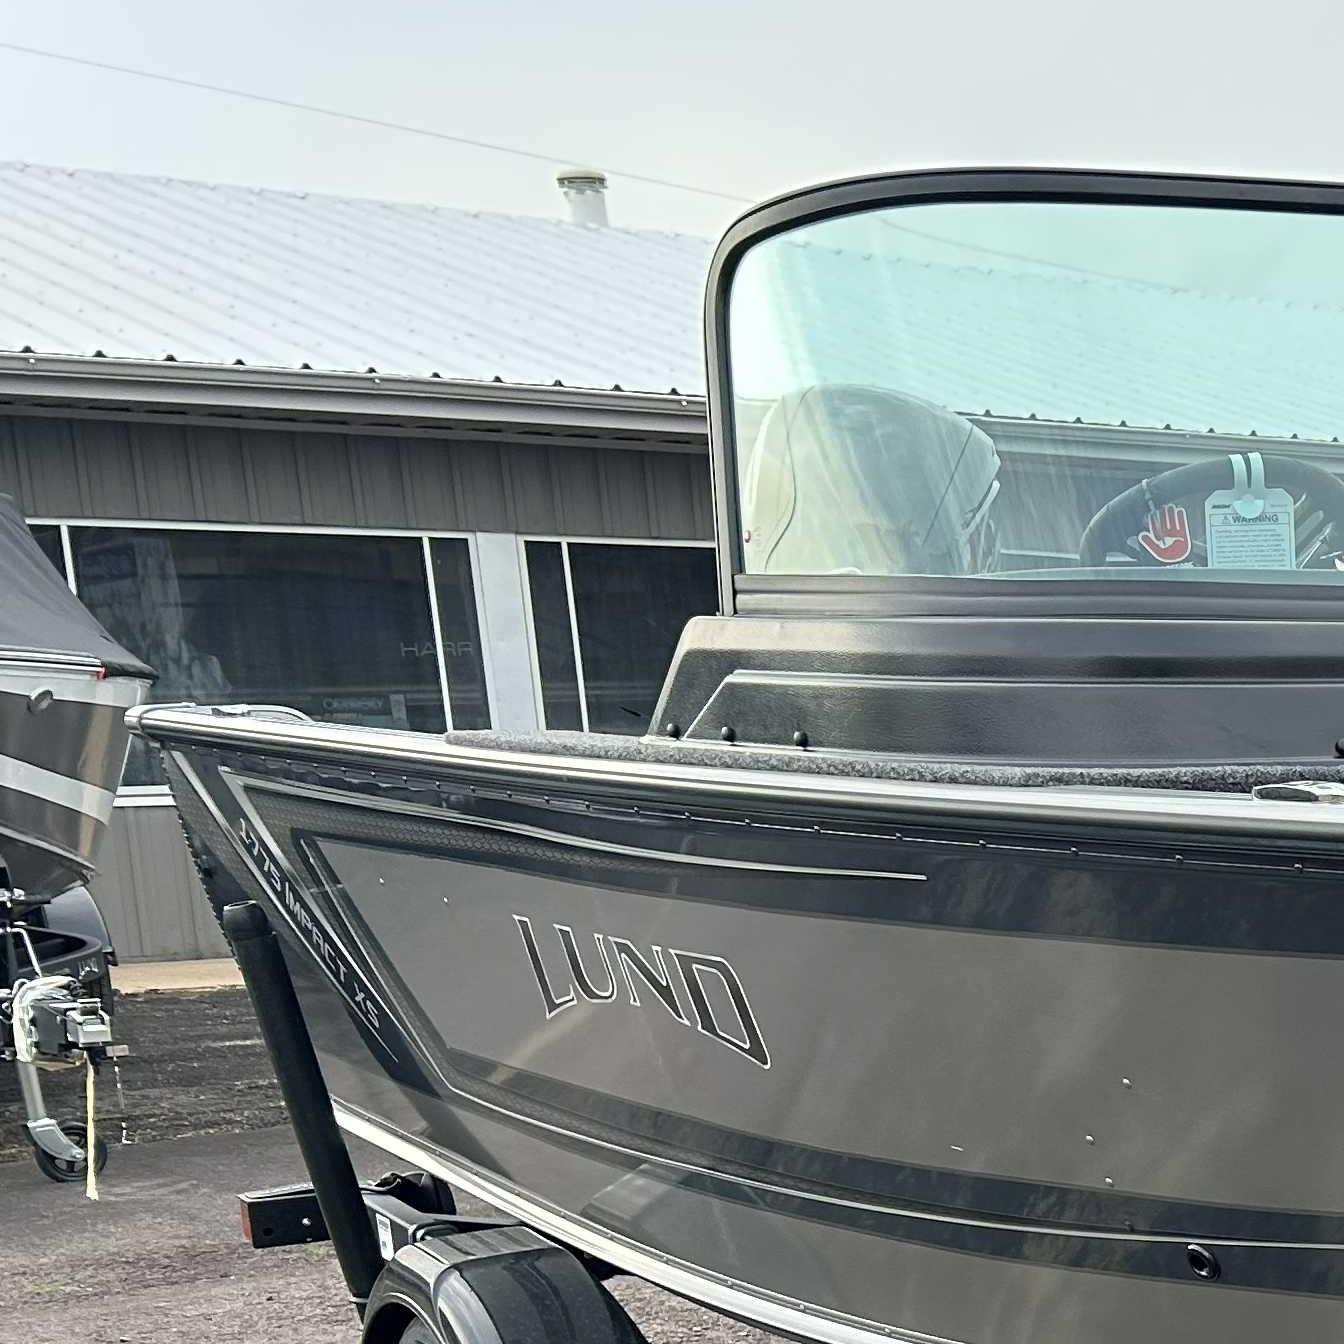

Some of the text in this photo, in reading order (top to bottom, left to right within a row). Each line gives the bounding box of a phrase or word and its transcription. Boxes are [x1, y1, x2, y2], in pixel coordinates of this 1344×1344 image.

[285, 881, 348, 983] IMPACT
[353, 982, 380, 1029] XS
[512, 914, 771, 1069] LUND
